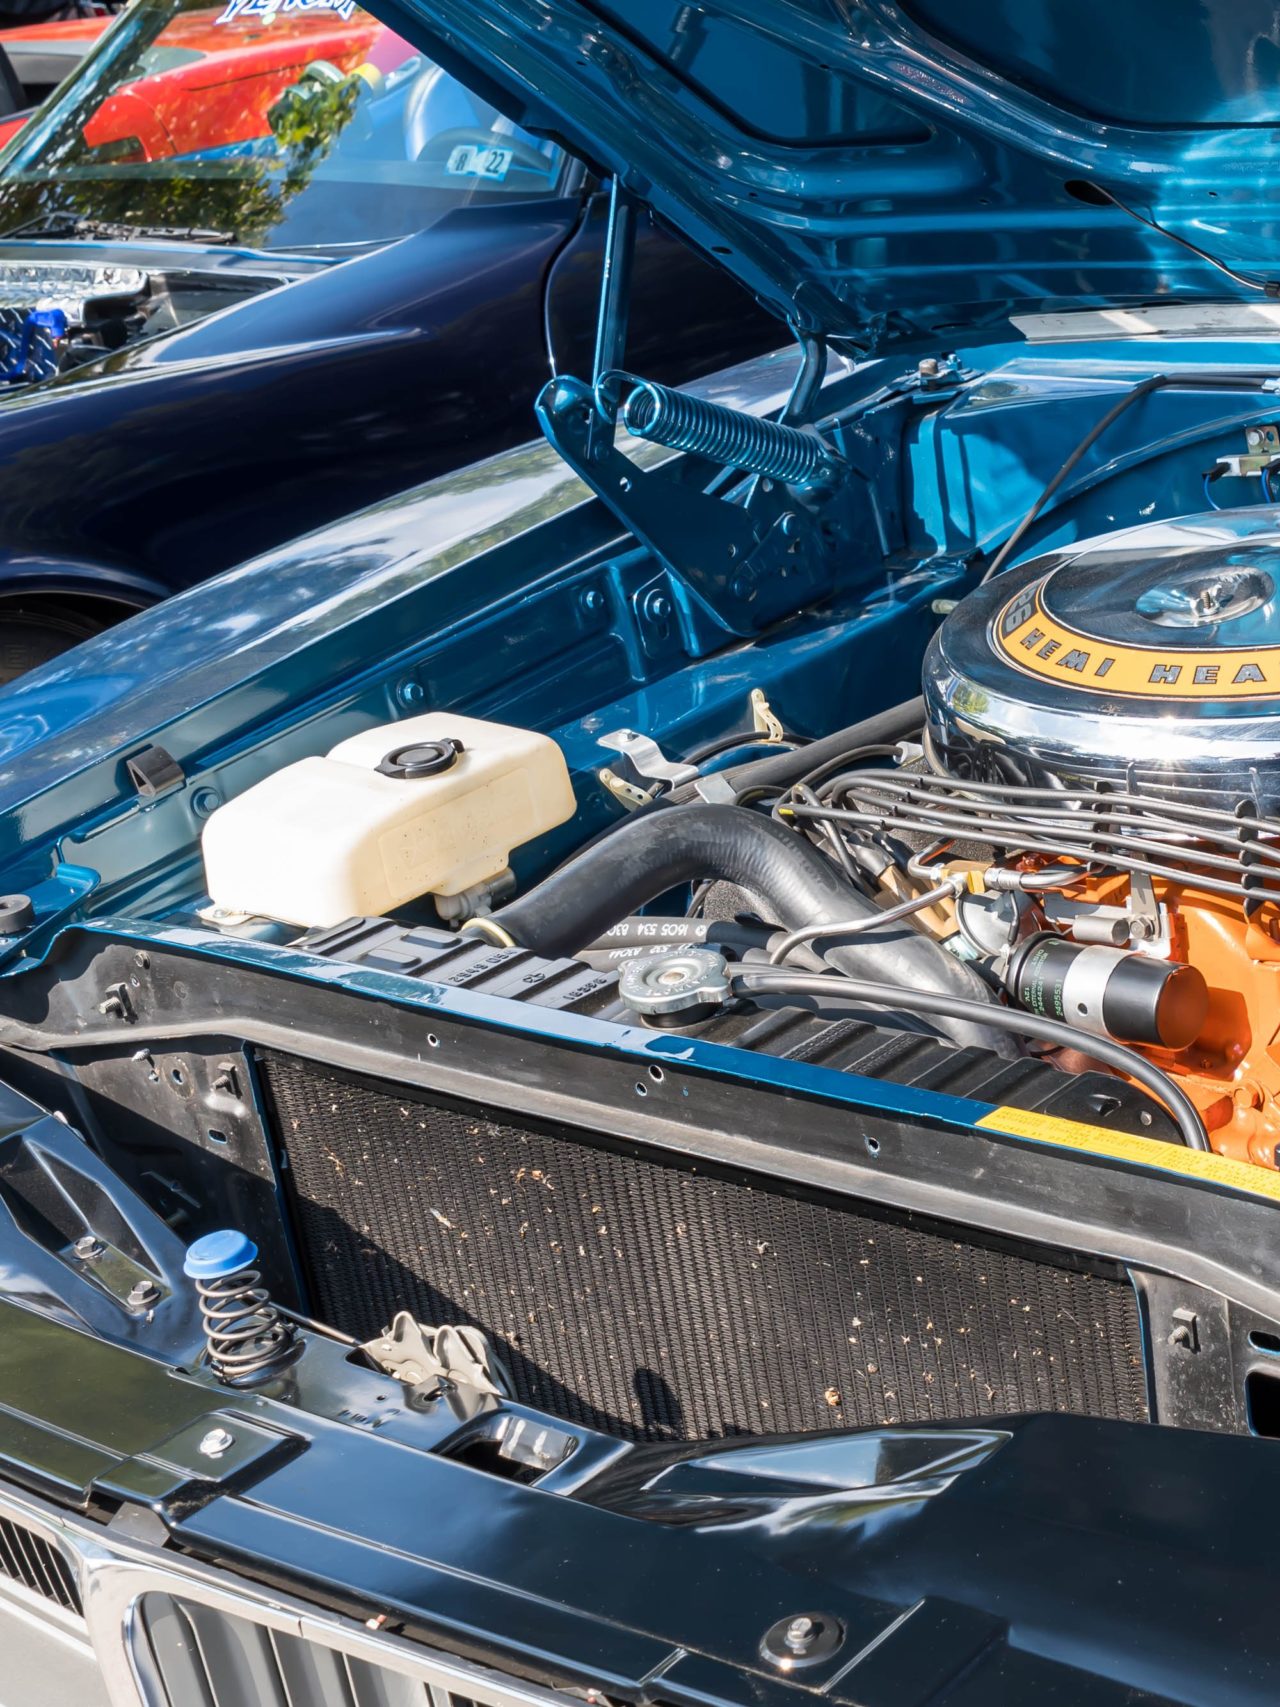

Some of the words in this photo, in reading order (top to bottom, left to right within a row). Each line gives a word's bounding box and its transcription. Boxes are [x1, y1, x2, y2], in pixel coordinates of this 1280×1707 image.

[485, 151, 505, 174] 22
[1019, 628, 1116, 678] HEMI
[637, 923, 658, 936] 534
[661, 923, 689, 936] 1605
